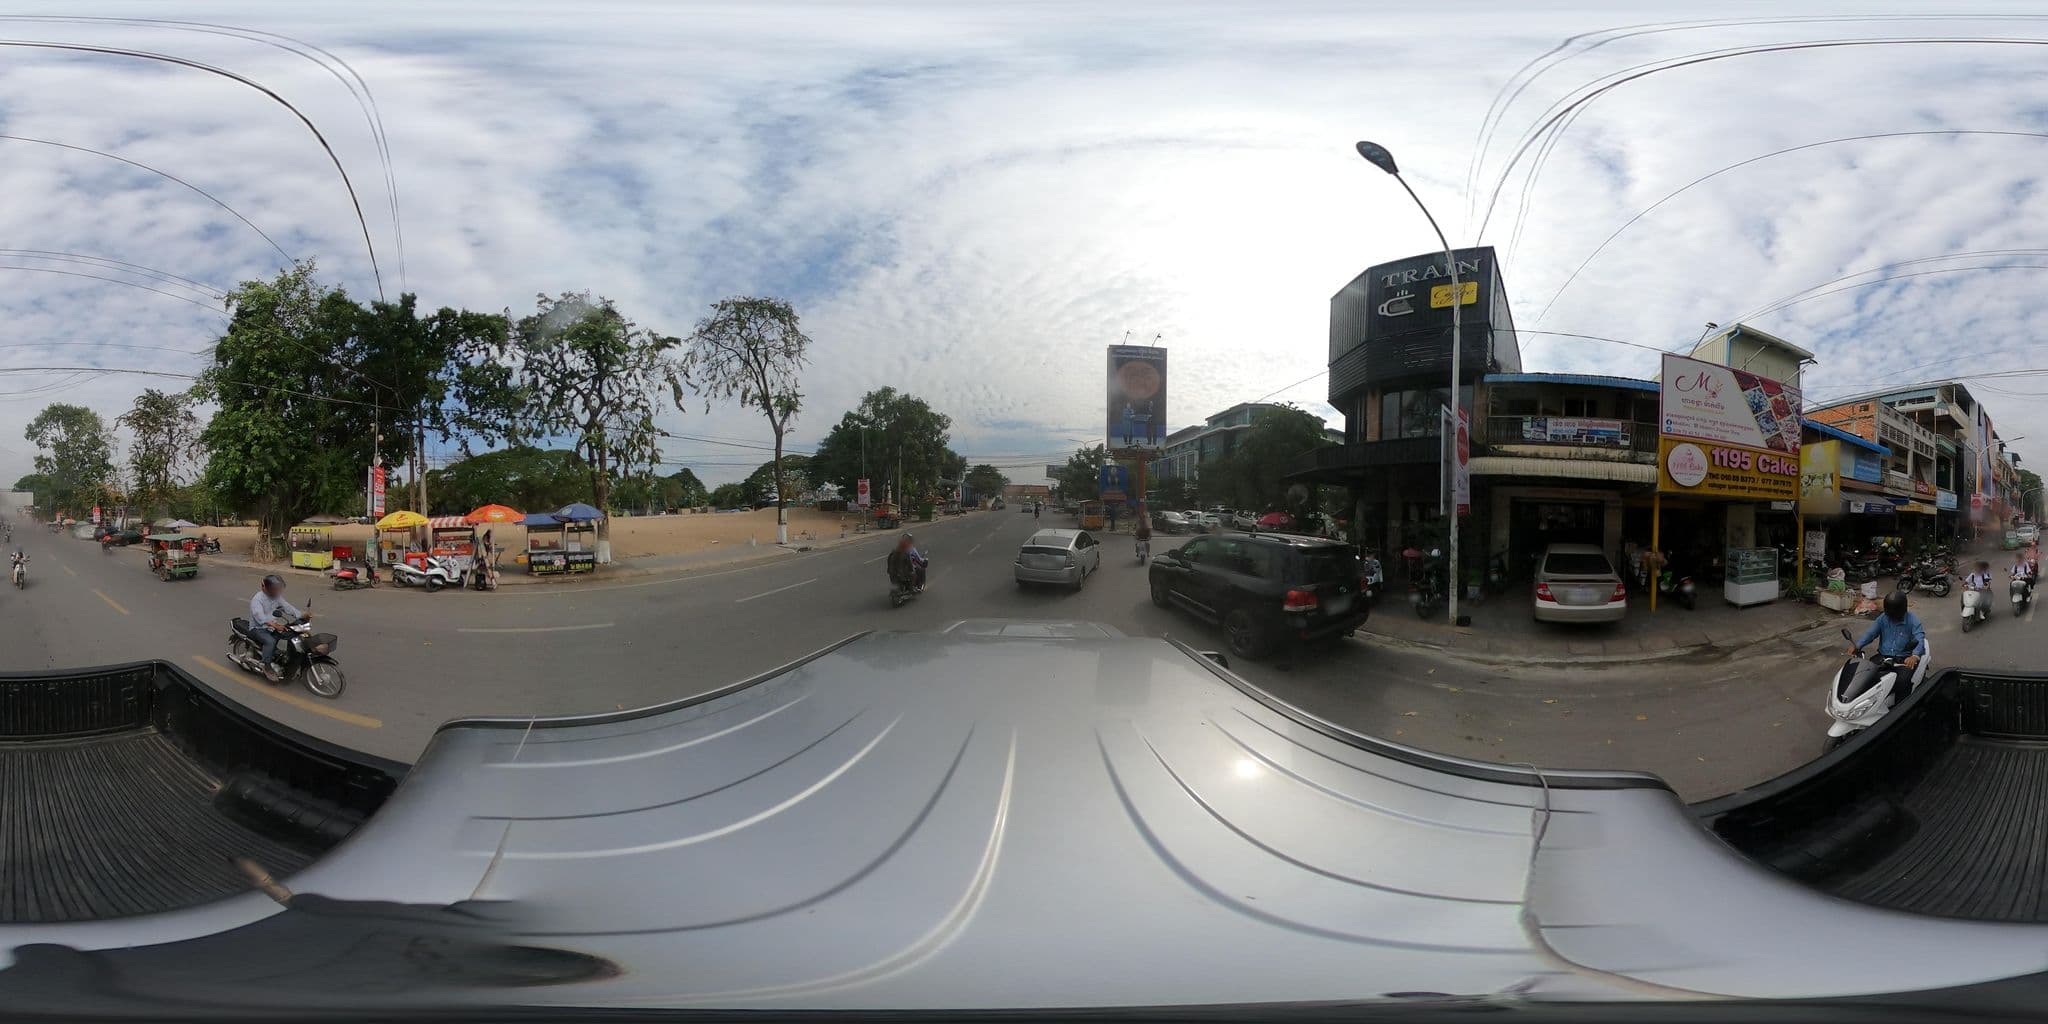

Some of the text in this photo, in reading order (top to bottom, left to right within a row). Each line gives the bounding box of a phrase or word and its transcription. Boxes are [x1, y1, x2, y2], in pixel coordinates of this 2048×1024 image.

[1382, 259, 1481, 288] TRAIN
[1712, 448, 1799, 476] 1195 Cake
